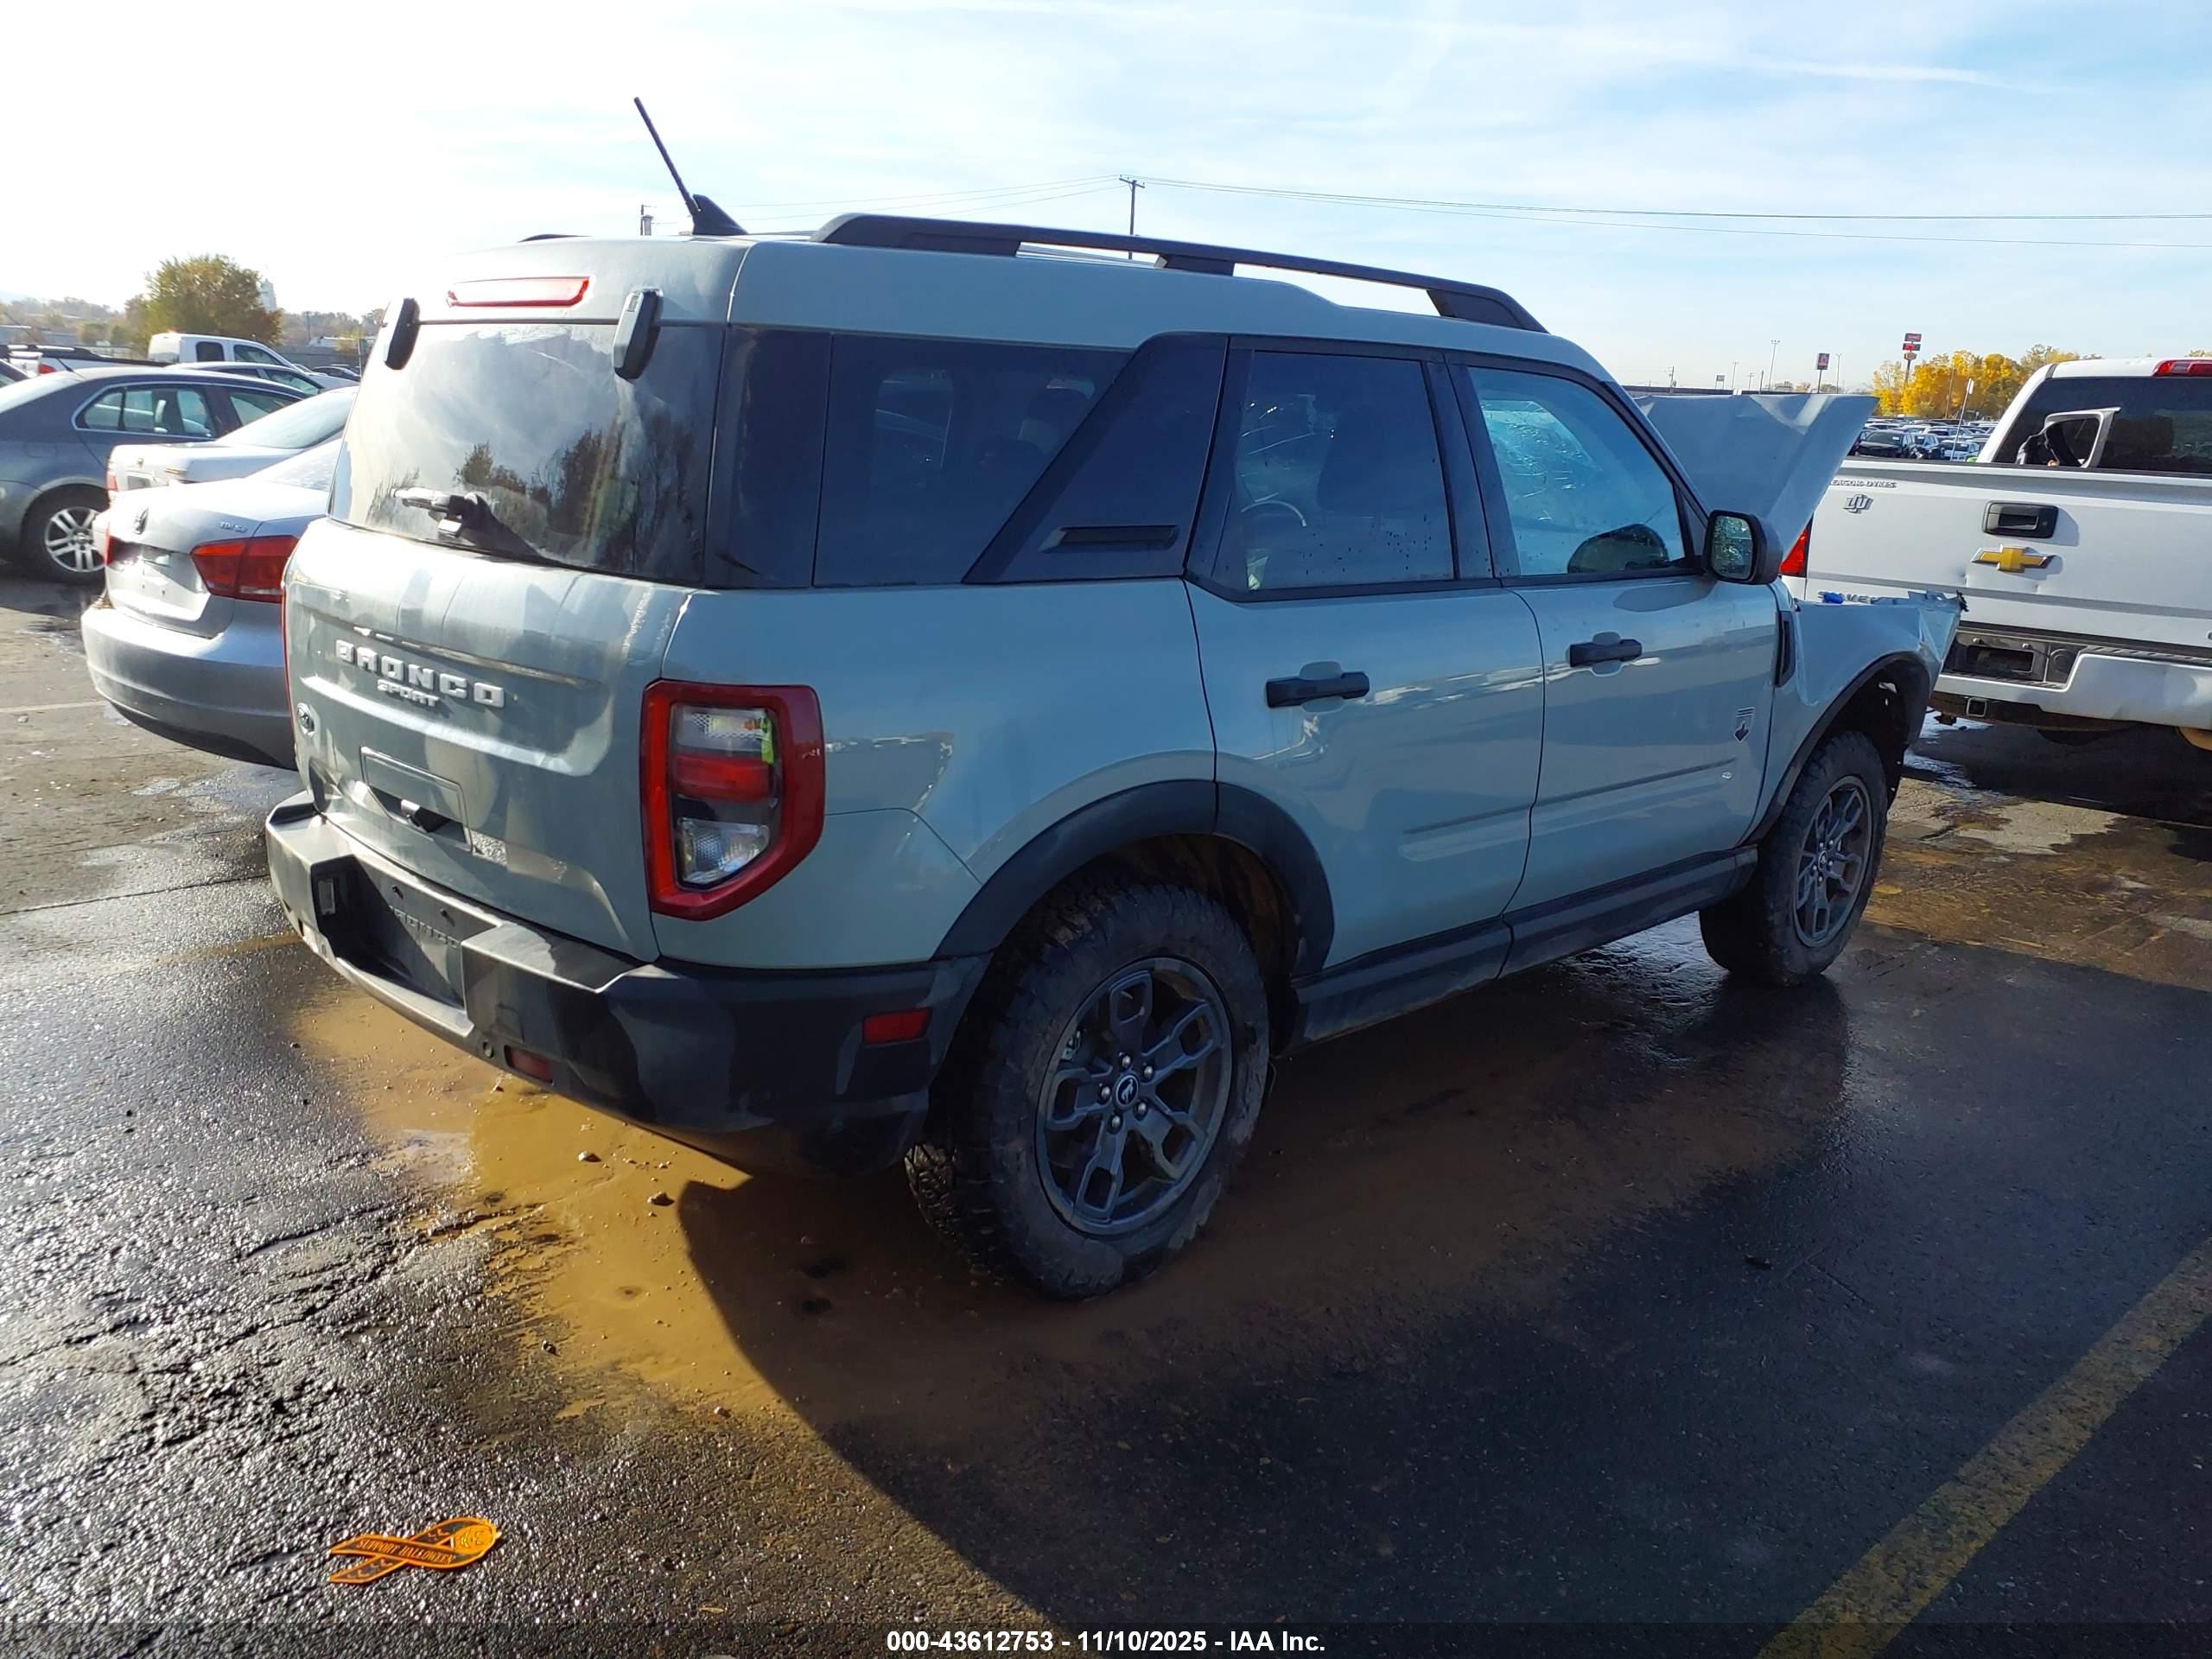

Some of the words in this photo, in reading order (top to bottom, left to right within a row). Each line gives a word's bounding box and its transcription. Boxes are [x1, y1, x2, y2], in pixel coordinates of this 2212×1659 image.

[335, 639, 505, 709] BRONCO
[377, 678, 442, 708] SPORT
[357, 1539, 400, 1554] SUPPORT
[398, 1545, 455, 1564] HALLOWEEN
